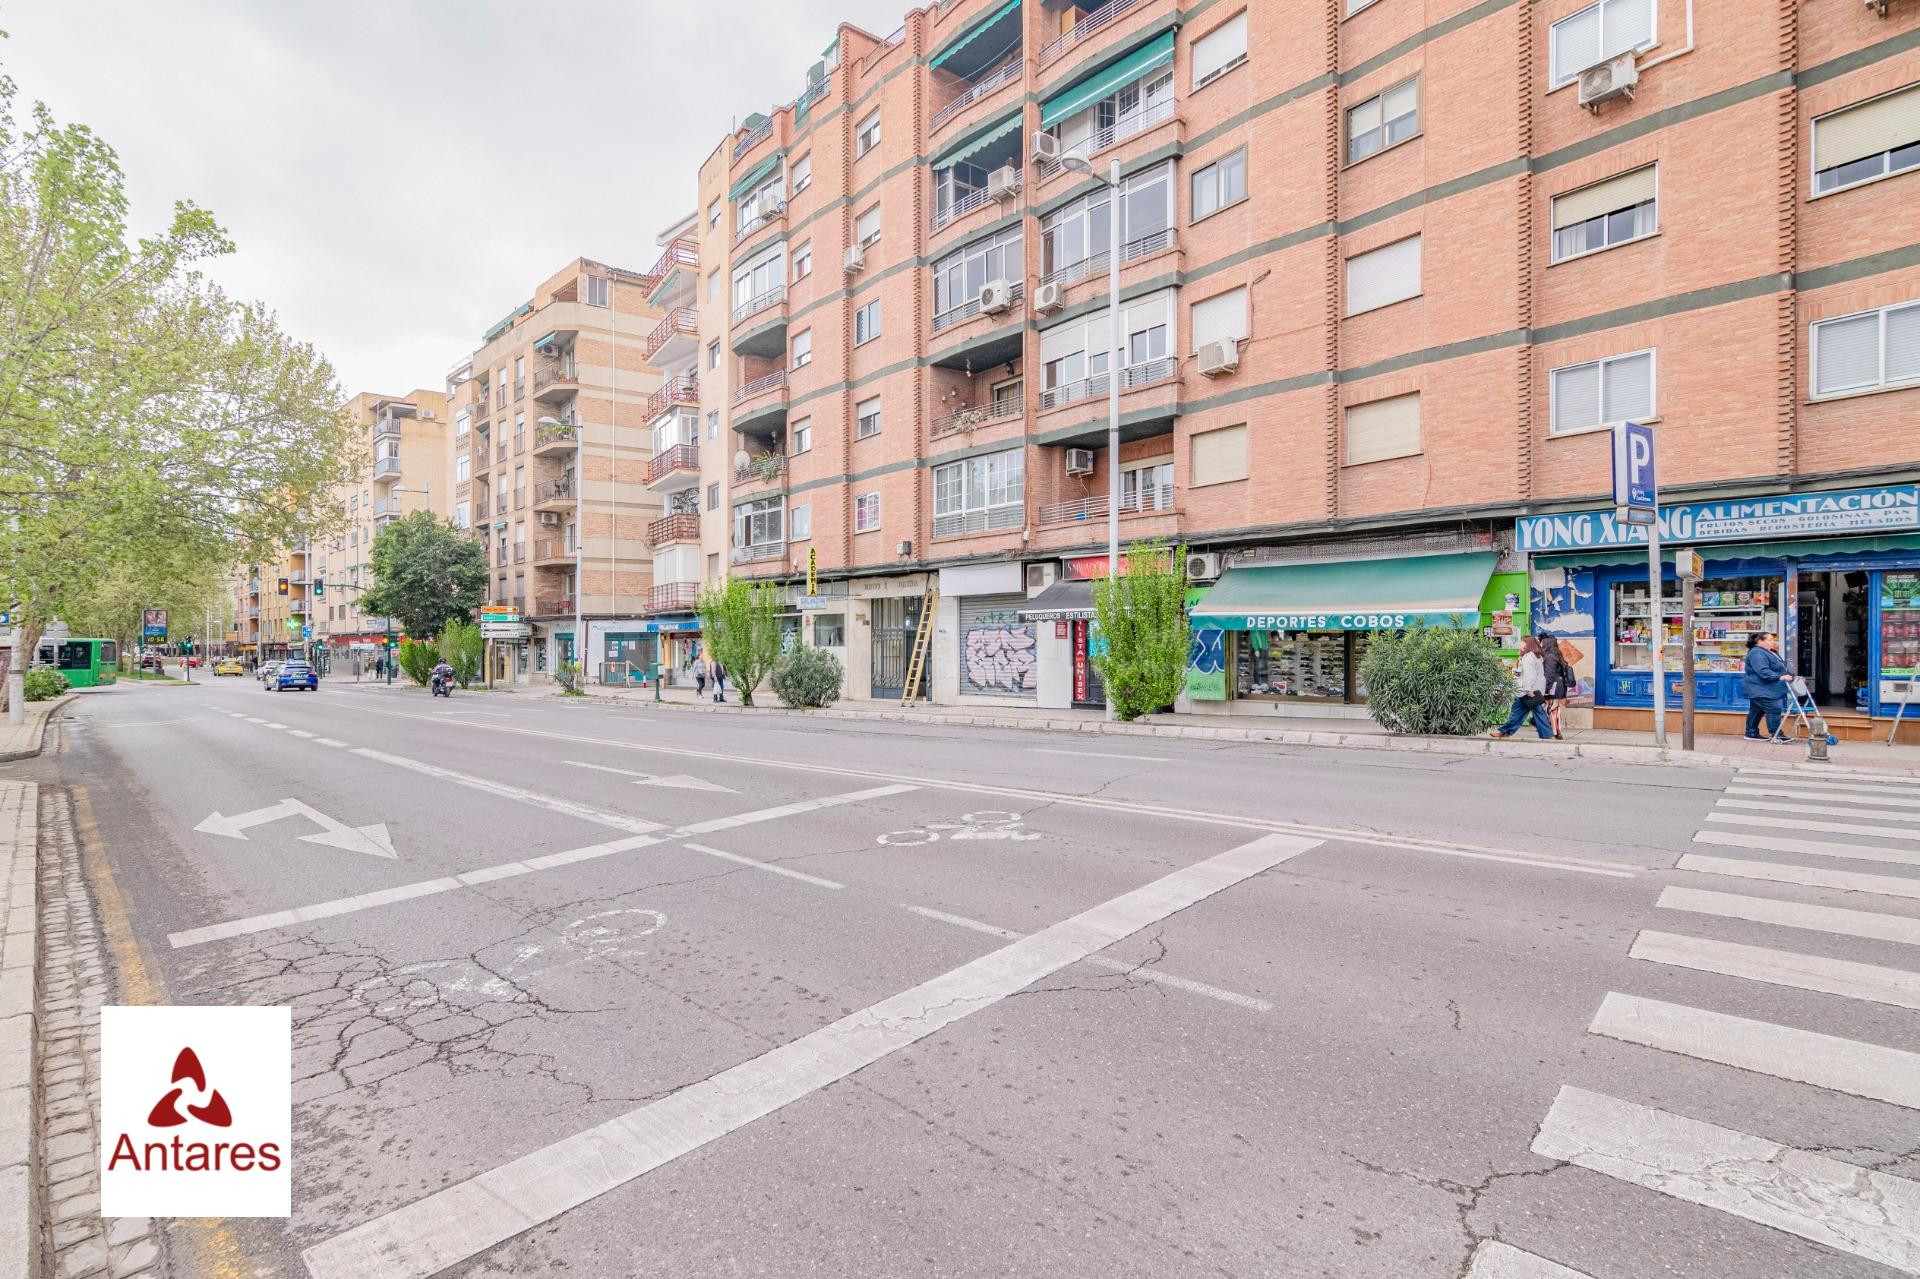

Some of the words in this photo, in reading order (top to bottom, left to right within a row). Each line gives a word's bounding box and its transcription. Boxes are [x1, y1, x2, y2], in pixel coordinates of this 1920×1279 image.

[1630, 433, 1650, 484] P
[1696, 490, 1918, 522] ALIMENTACIÓN
[1520, 514, 1592, 548] YONG
[1600, 506, 1692, 544] XIANG
[1699, 521, 1744, 529] FRUTOS
[1749, 518, 1786, 526] SECOS
[1798, 511, 1870, 522] GOLOSINAS
[1699, 528, 1748, 536] BEBIDAS
[1850, 516, 1912, 526] HELADOS
[1025, 612, 1061, 621] PELUQUEROS
[1247, 616, 1326, 628] DEPORTES
[1340, 614, 1405, 628] COBOS
